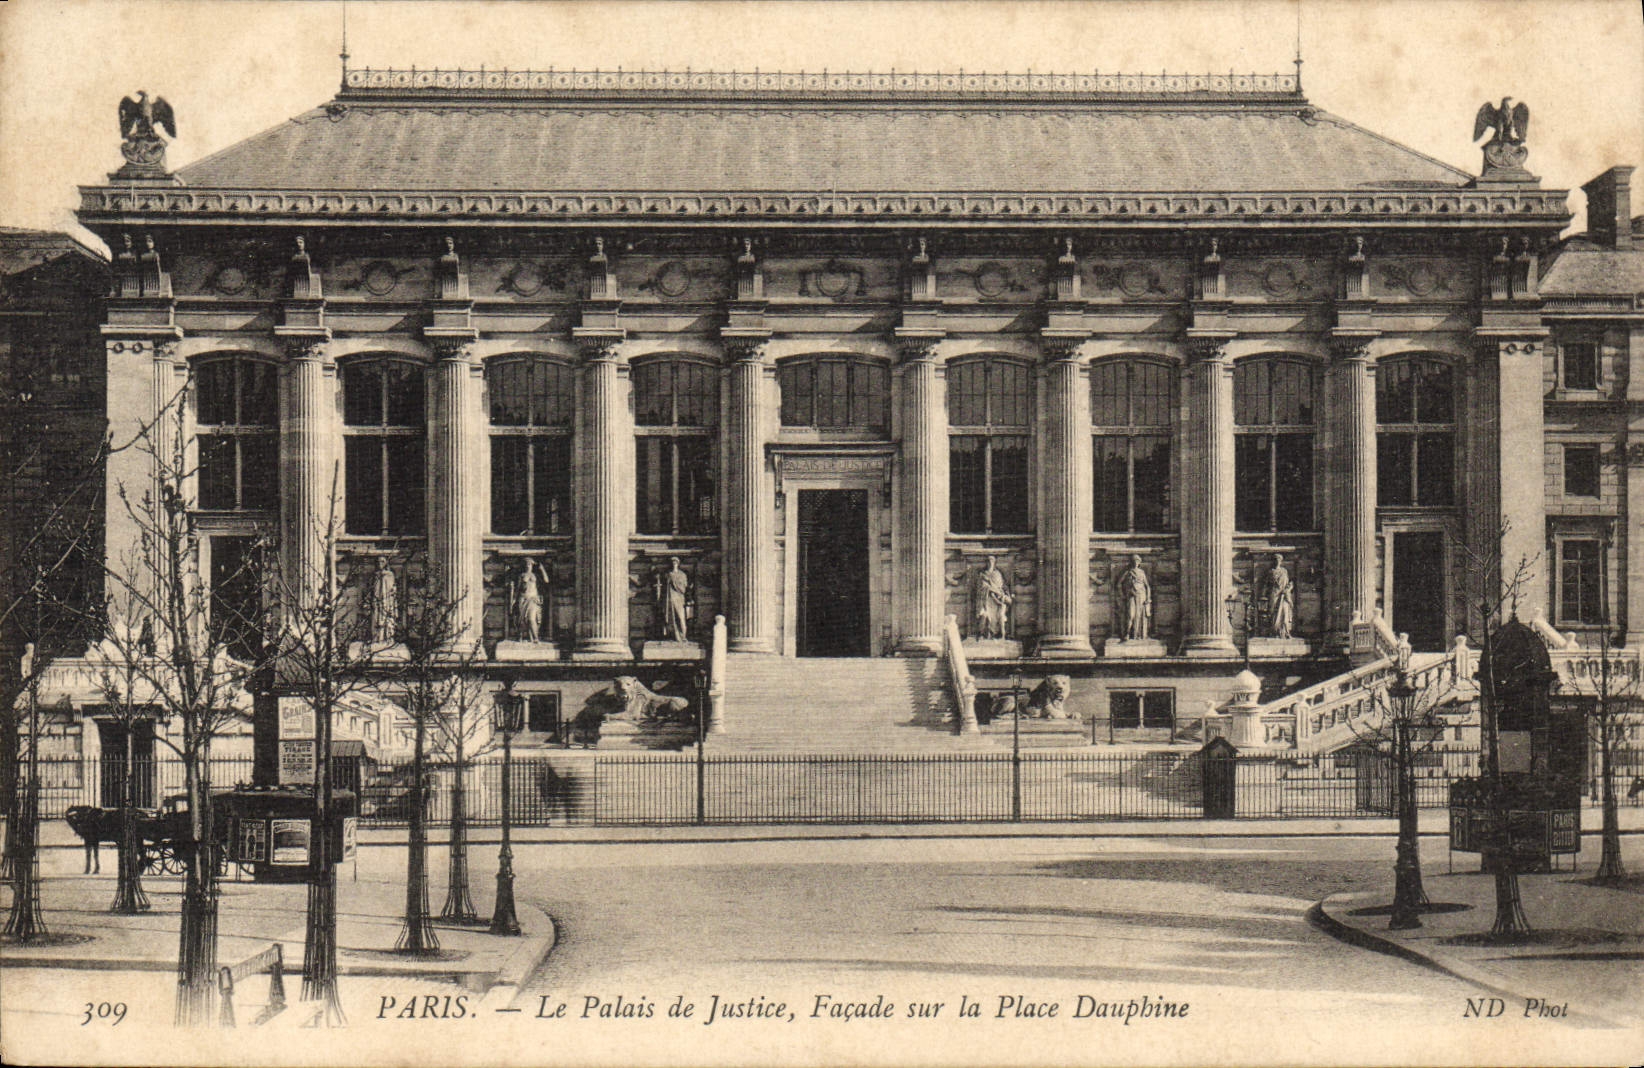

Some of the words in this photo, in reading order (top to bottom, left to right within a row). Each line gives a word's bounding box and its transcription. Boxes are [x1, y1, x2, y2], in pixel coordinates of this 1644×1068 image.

[783, 458, 819, 471] PALAIS
[823, 458, 836, 471] DE
[839, 458, 884, 472] JUSTICE
